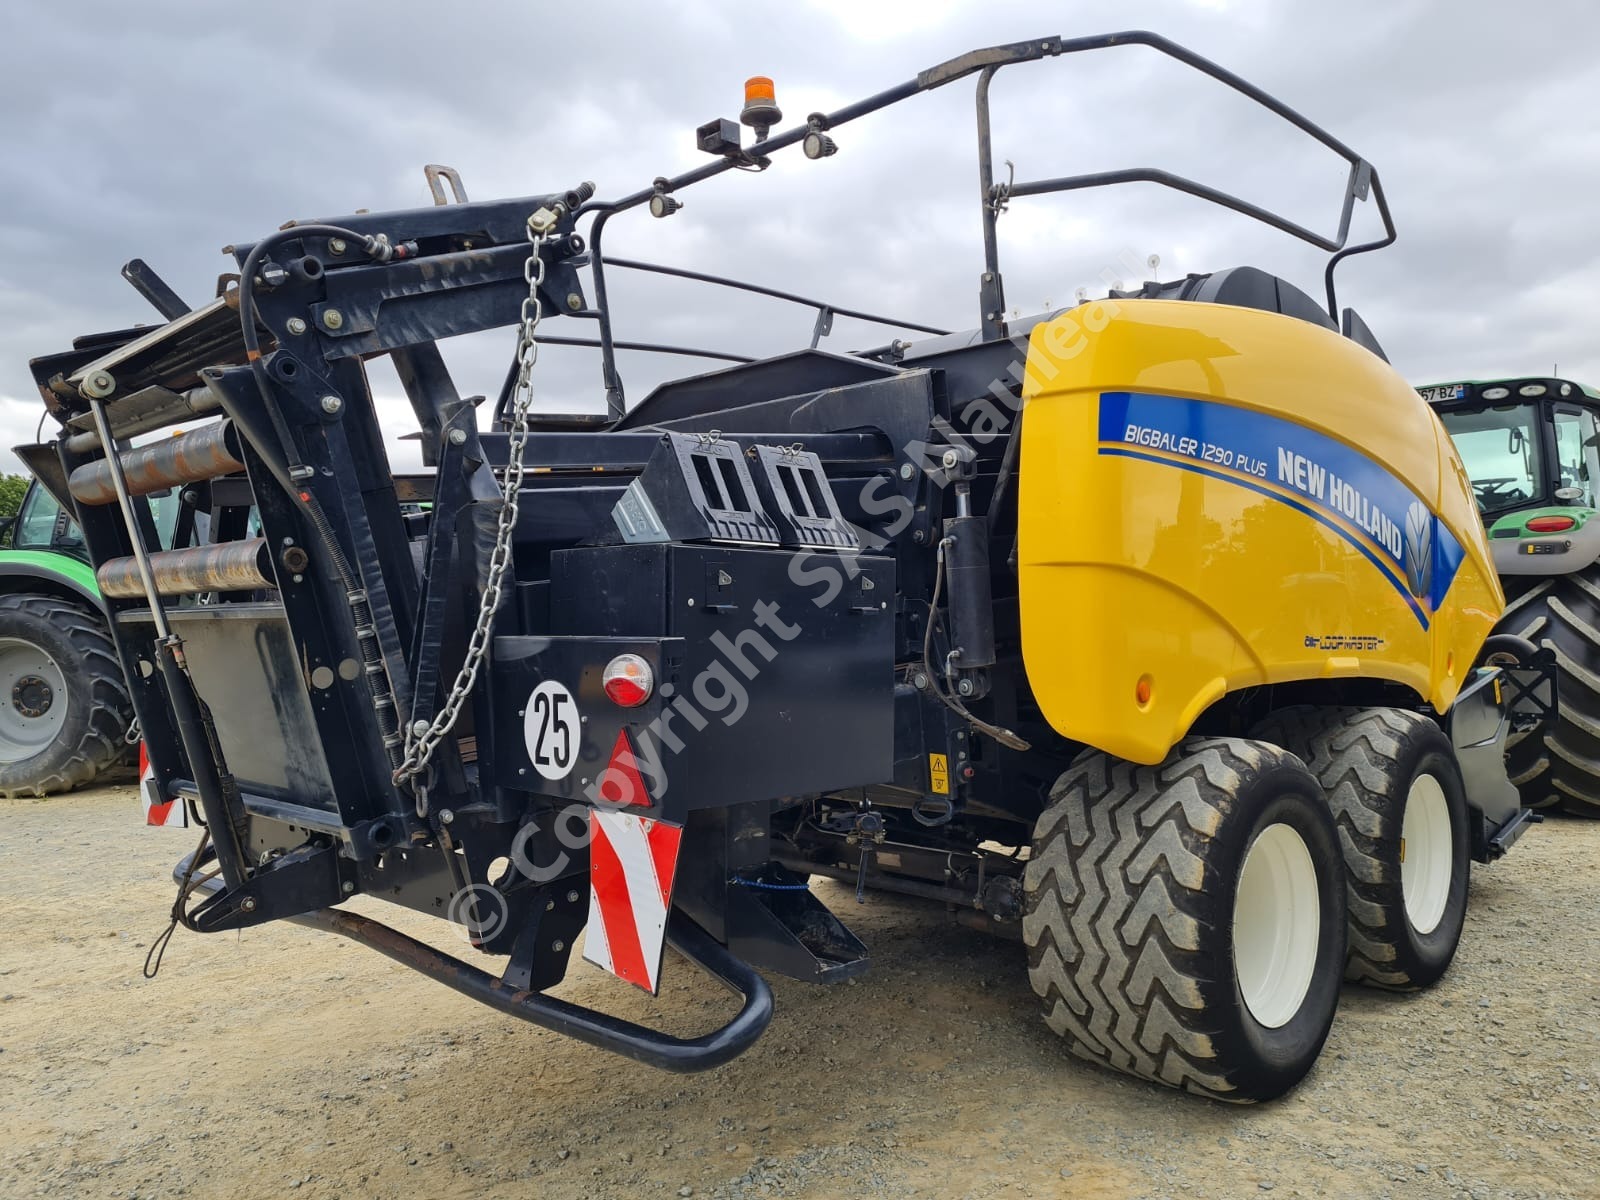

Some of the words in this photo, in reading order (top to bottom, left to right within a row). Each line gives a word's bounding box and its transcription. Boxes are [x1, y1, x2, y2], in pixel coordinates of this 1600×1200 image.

[1124, 424, 1198, 456] BIGBALER
[1201, 443, 1233, 466] 1290
[1236, 454, 1268, 477] PLUS
[1278, 446, 1326, 500] NEW
[1329, 473, 1402, 560] HOLLAND
[534, 692, 570, 769] 25
